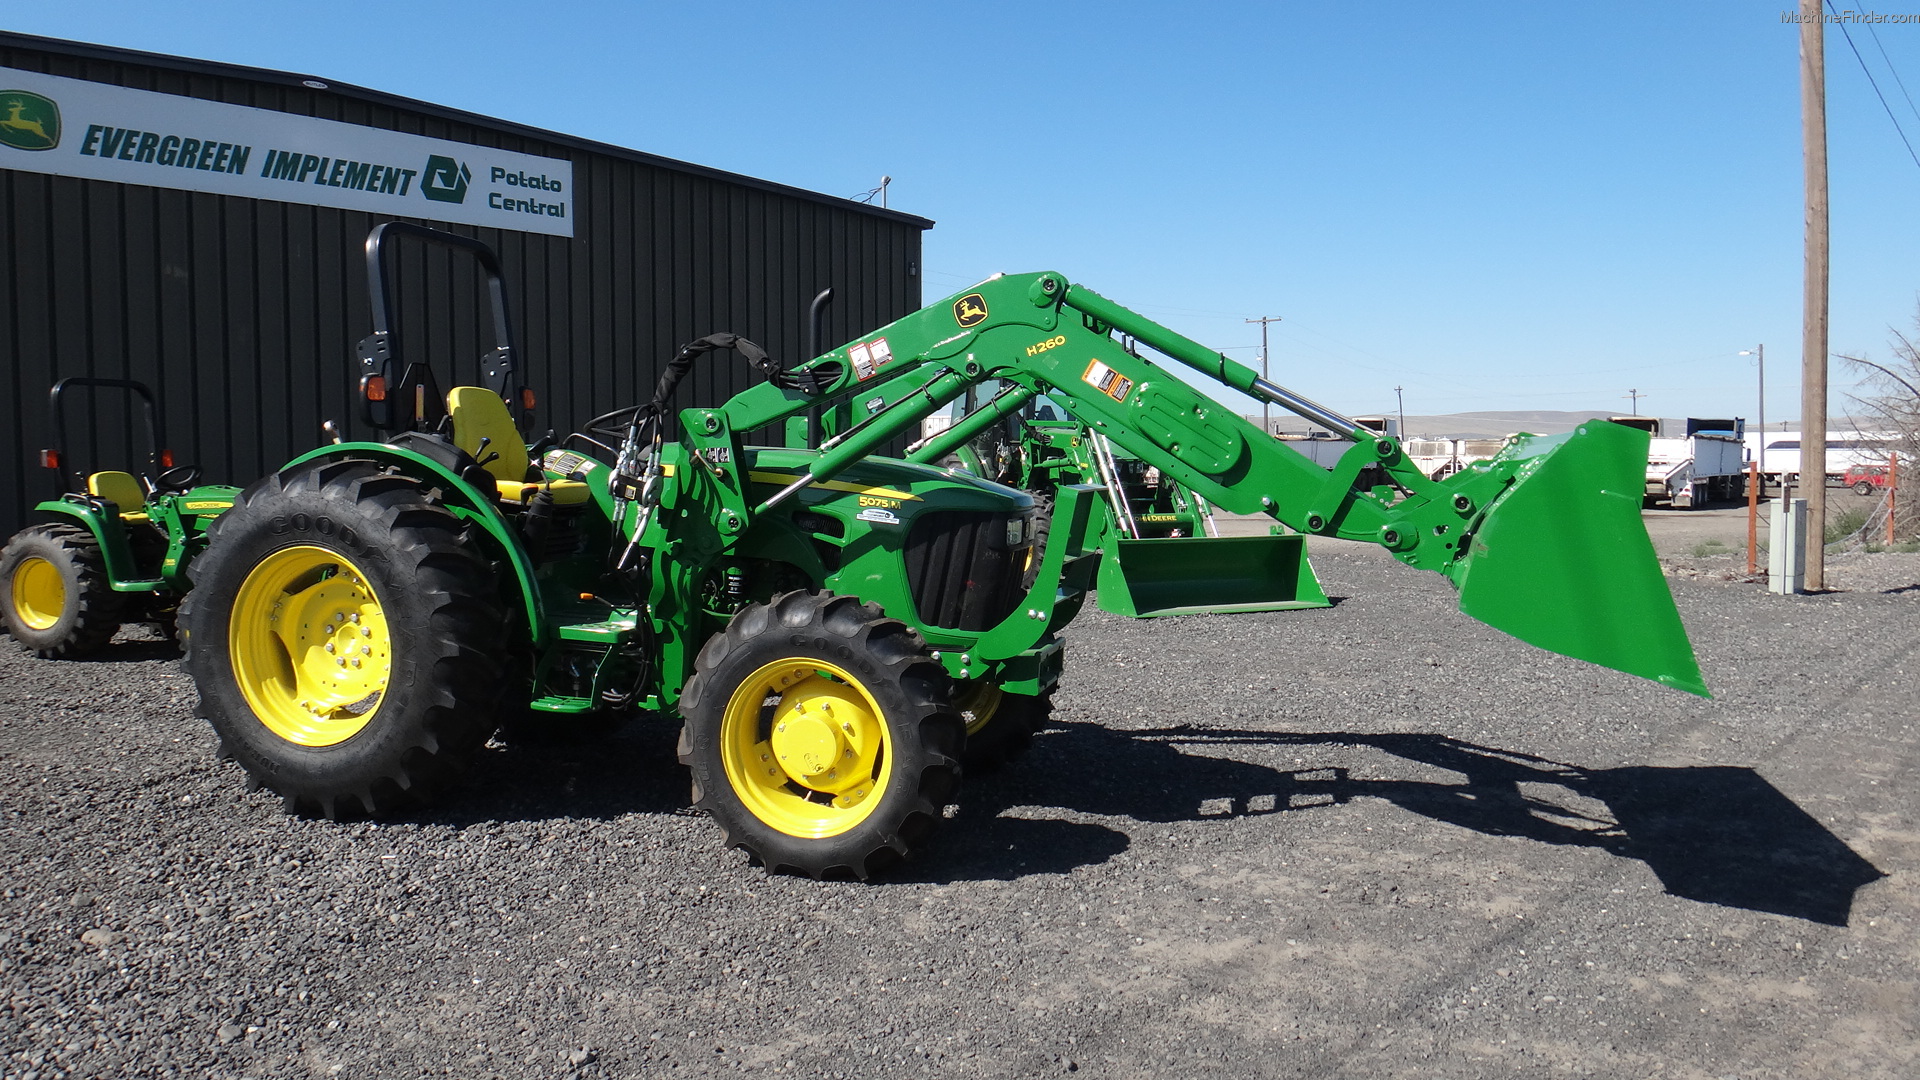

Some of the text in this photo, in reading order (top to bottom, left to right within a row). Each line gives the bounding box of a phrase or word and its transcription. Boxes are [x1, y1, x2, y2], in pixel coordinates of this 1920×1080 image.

[80, 124, 417, 196] EVERGREEN IMPLEMENT
[491, 166, 562, 192] Potato
[488, 192, 565, 218] Central
[1026, 335, 1066, 357] H260
